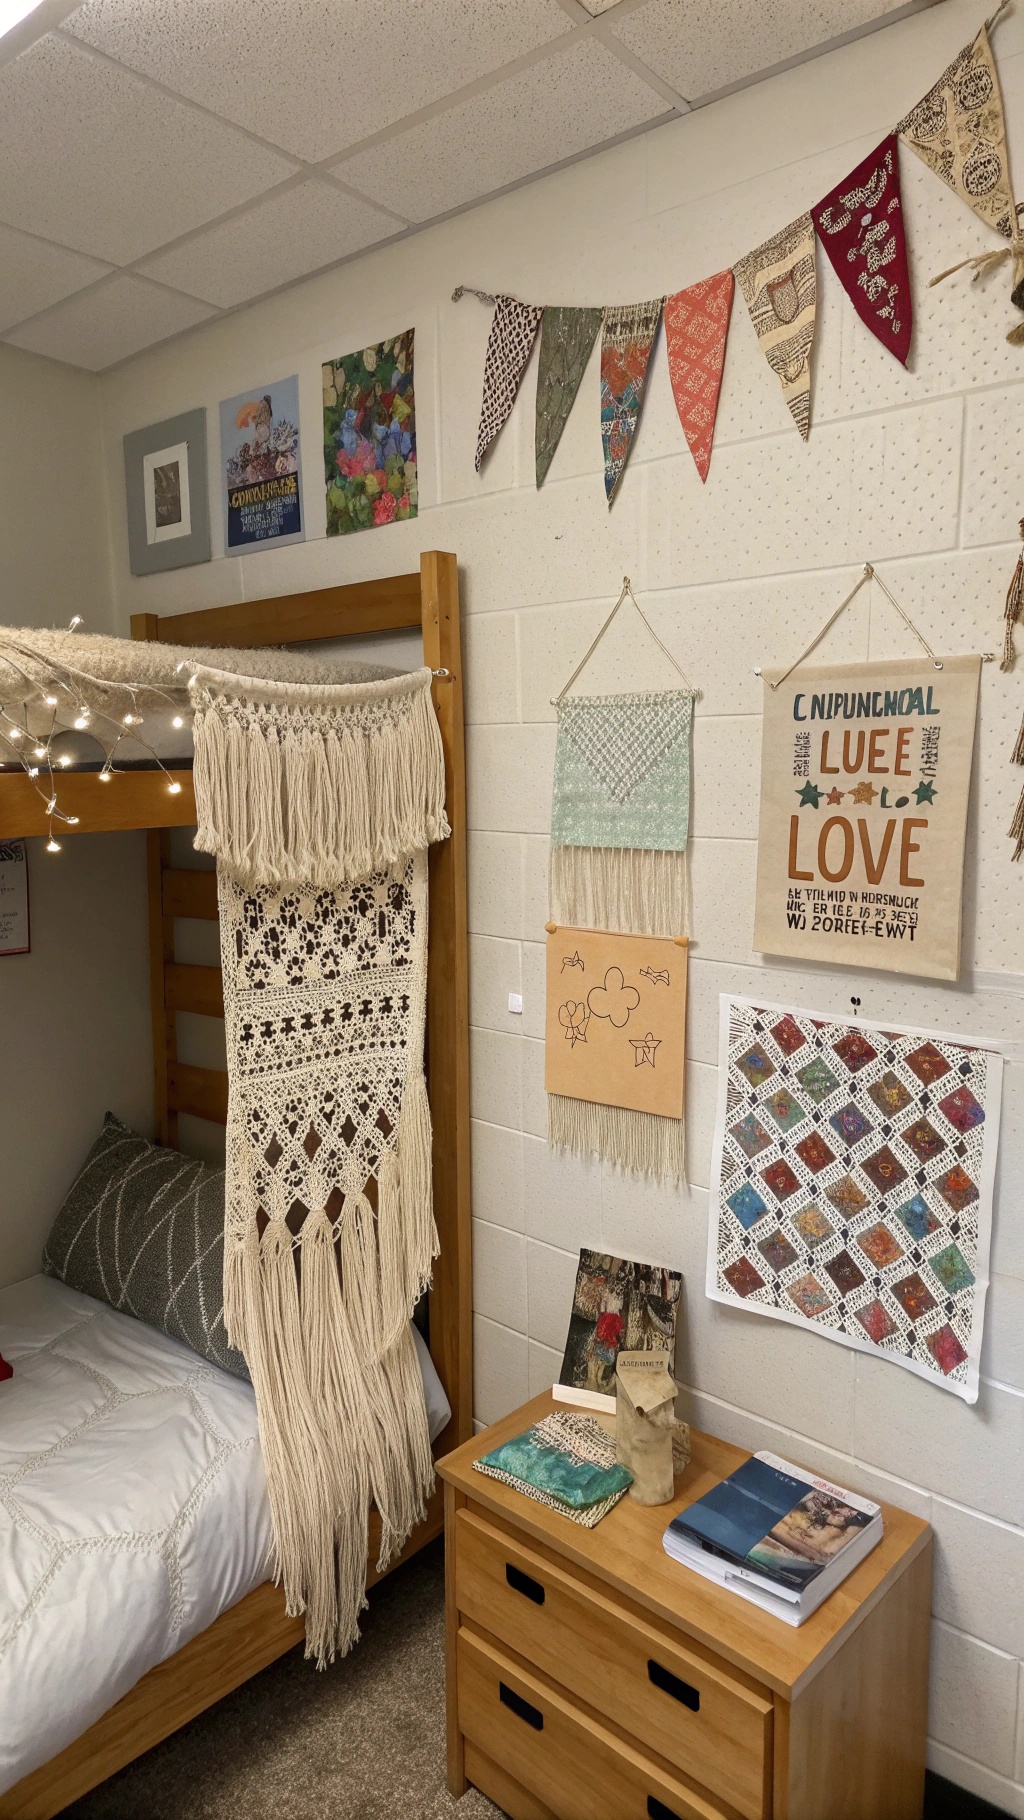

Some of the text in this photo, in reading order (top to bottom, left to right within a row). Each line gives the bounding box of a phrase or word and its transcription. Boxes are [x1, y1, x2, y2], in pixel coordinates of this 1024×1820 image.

[820, 727, 914, 776] LUEE
[788, 814, 929, 887] LOVE
[813, 903, 827, 915] ER
